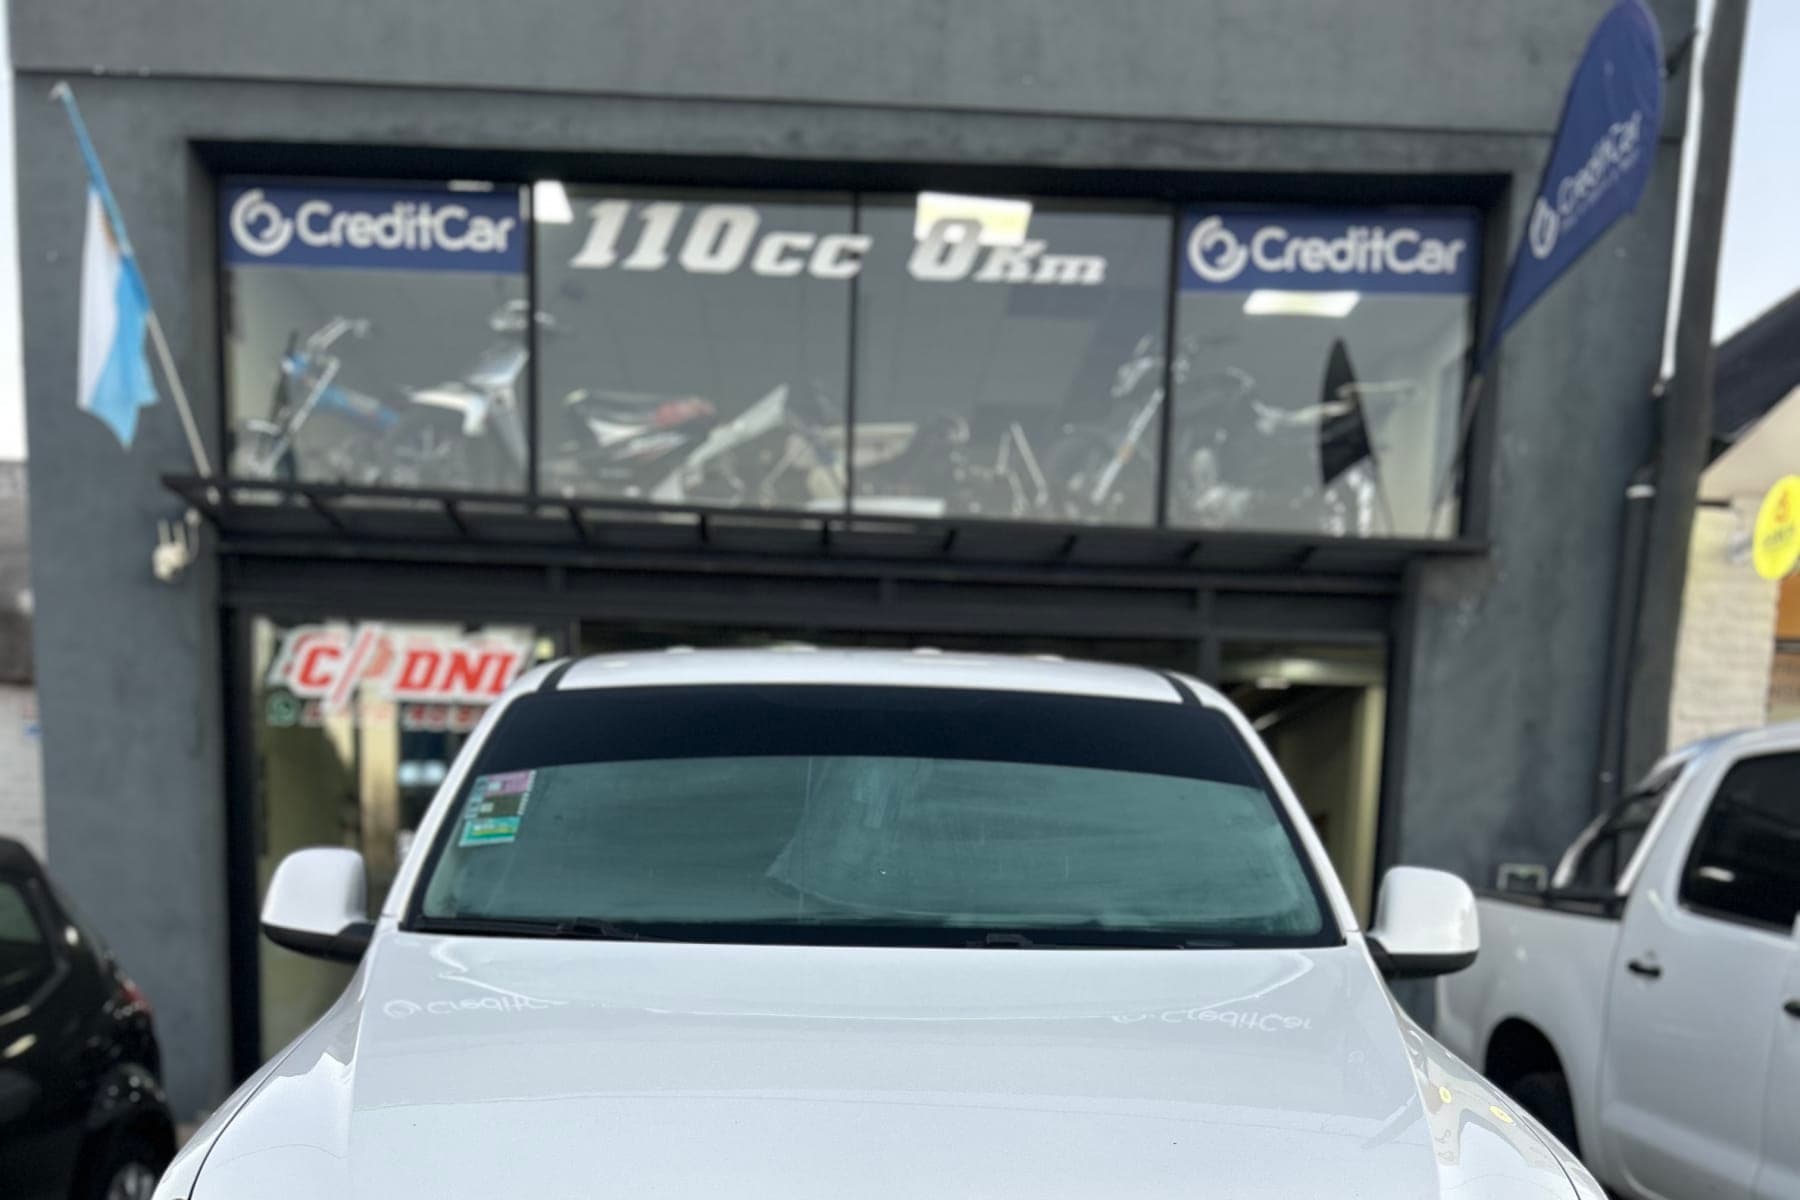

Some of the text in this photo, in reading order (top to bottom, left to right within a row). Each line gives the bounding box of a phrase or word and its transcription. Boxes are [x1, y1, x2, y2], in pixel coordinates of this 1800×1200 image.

[296, 200, 515, 252] CreditCar
[569, 199, 872, 278] 110cc
[1250, 225, 1467, 274] CreditCar
